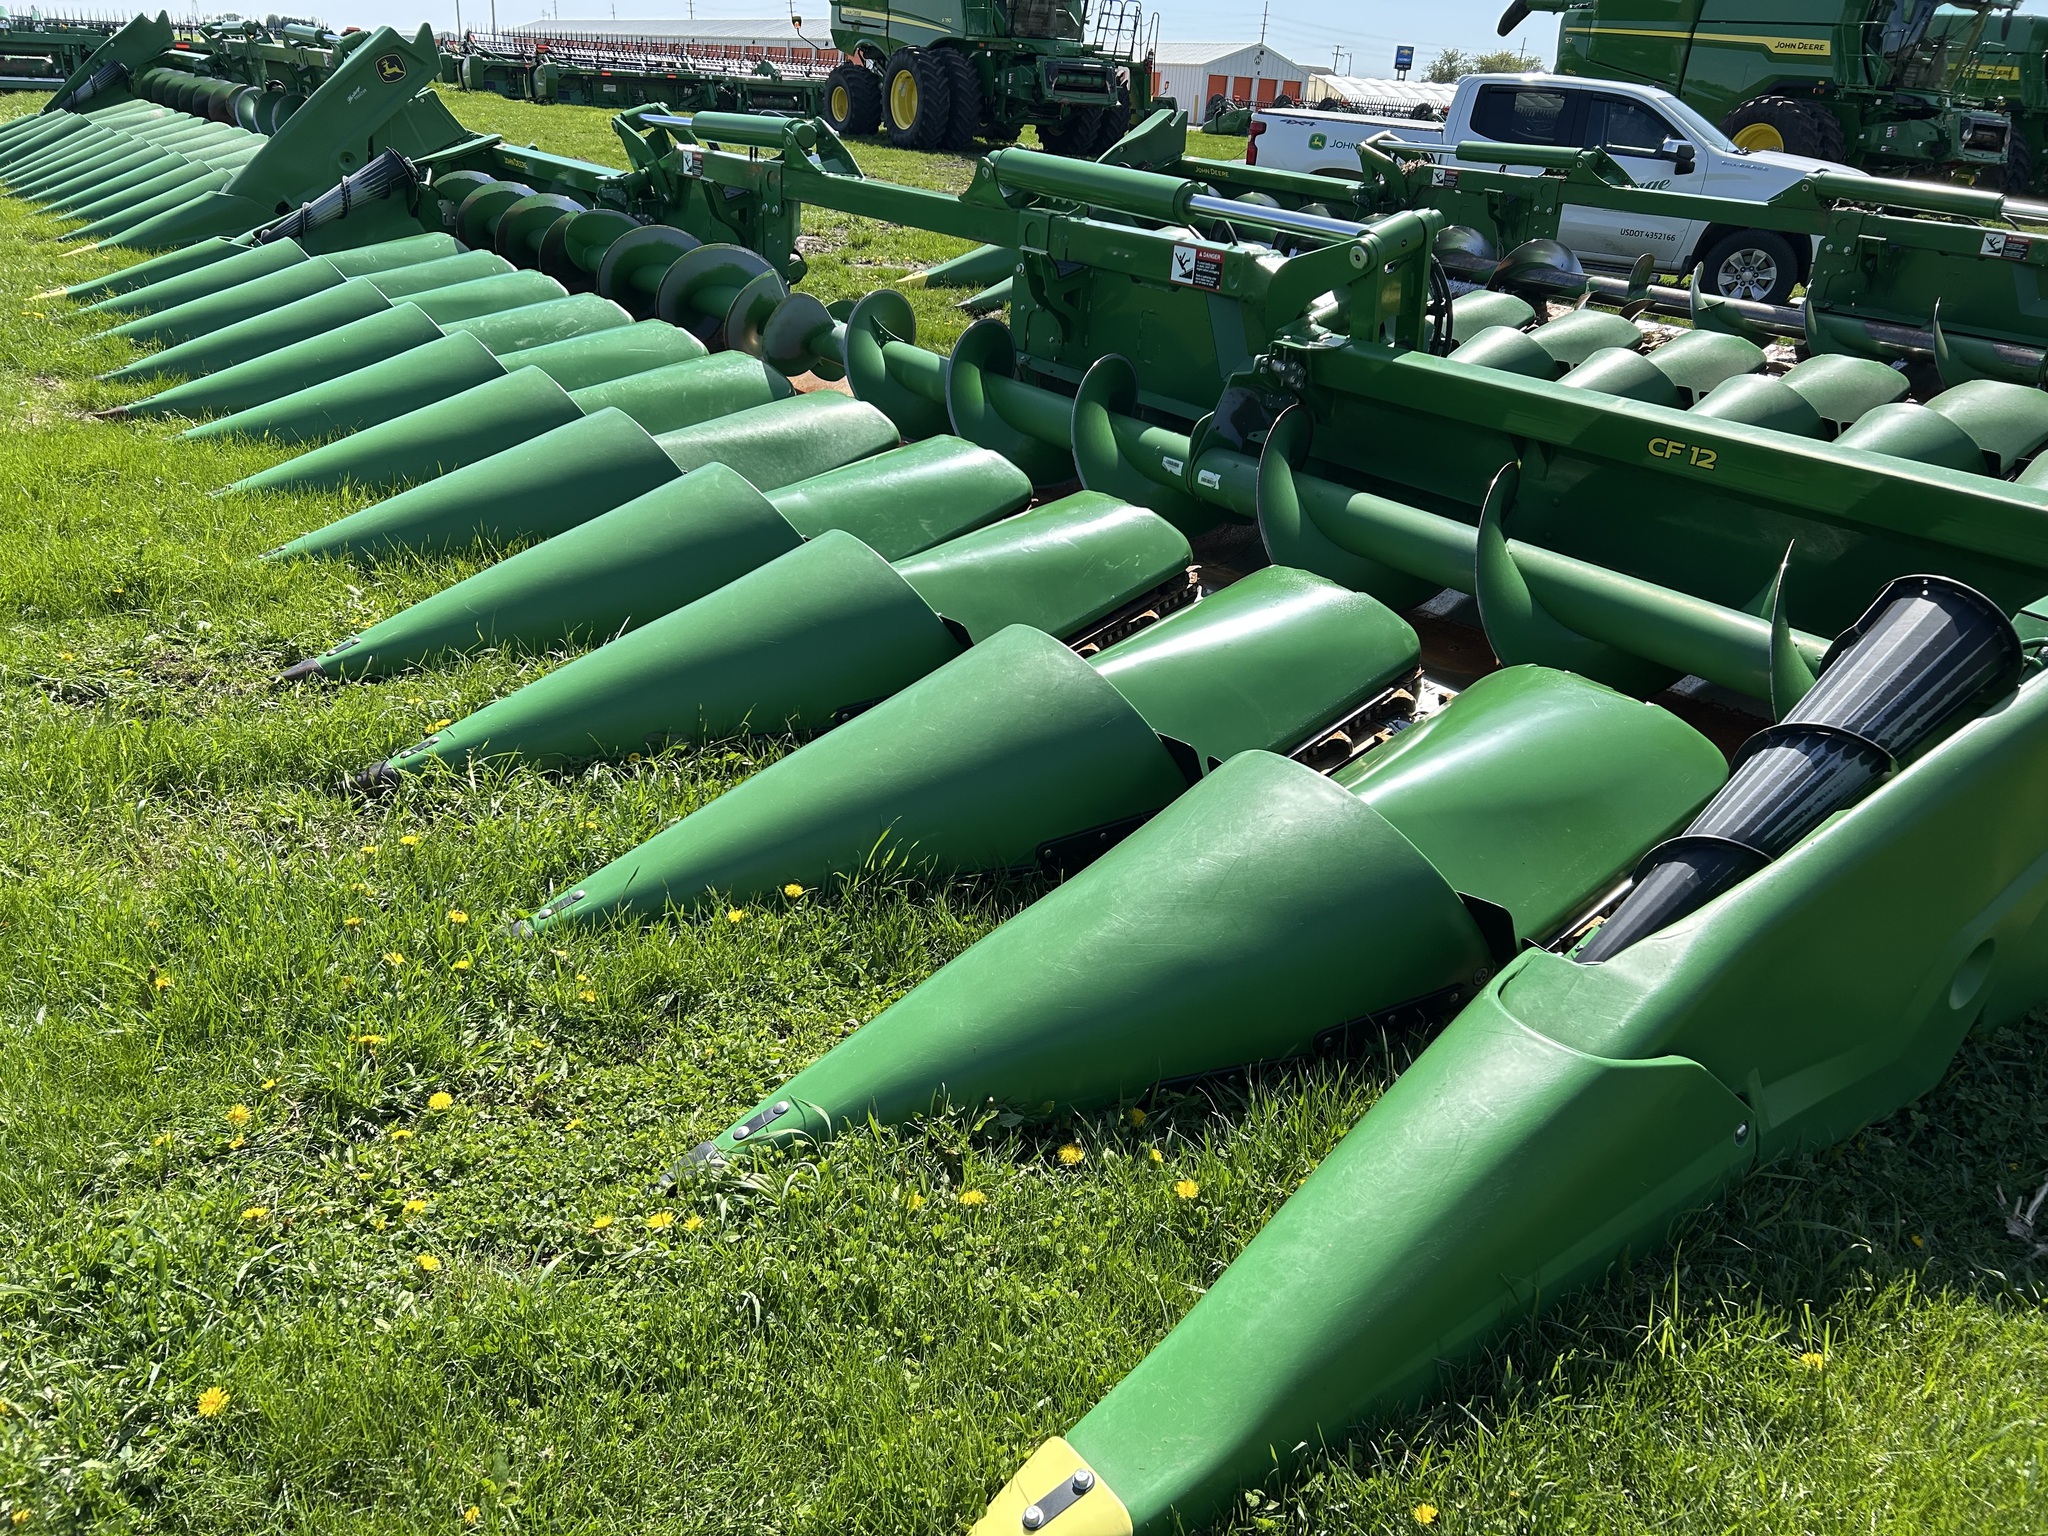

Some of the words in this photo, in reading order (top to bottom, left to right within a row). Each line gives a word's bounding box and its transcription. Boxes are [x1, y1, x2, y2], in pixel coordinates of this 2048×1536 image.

[1774, 41, 1796, 49] JOHN
[1797, 42, 1825, 51] DEERE
[1329, 139, 1358, 150] JOHN
[1195, 166, 1210, 174] JOHN
[1210, 168, 1229, 178] DEERE
[1620, 228, 1644, 238] USDOT
[1644, 230, 1676, 242] 4352166
[1202, 251, 1221, 261] DANGER
[1647, 437, 1686, 460] CF
[1689, 445, 1718, 471] 12
